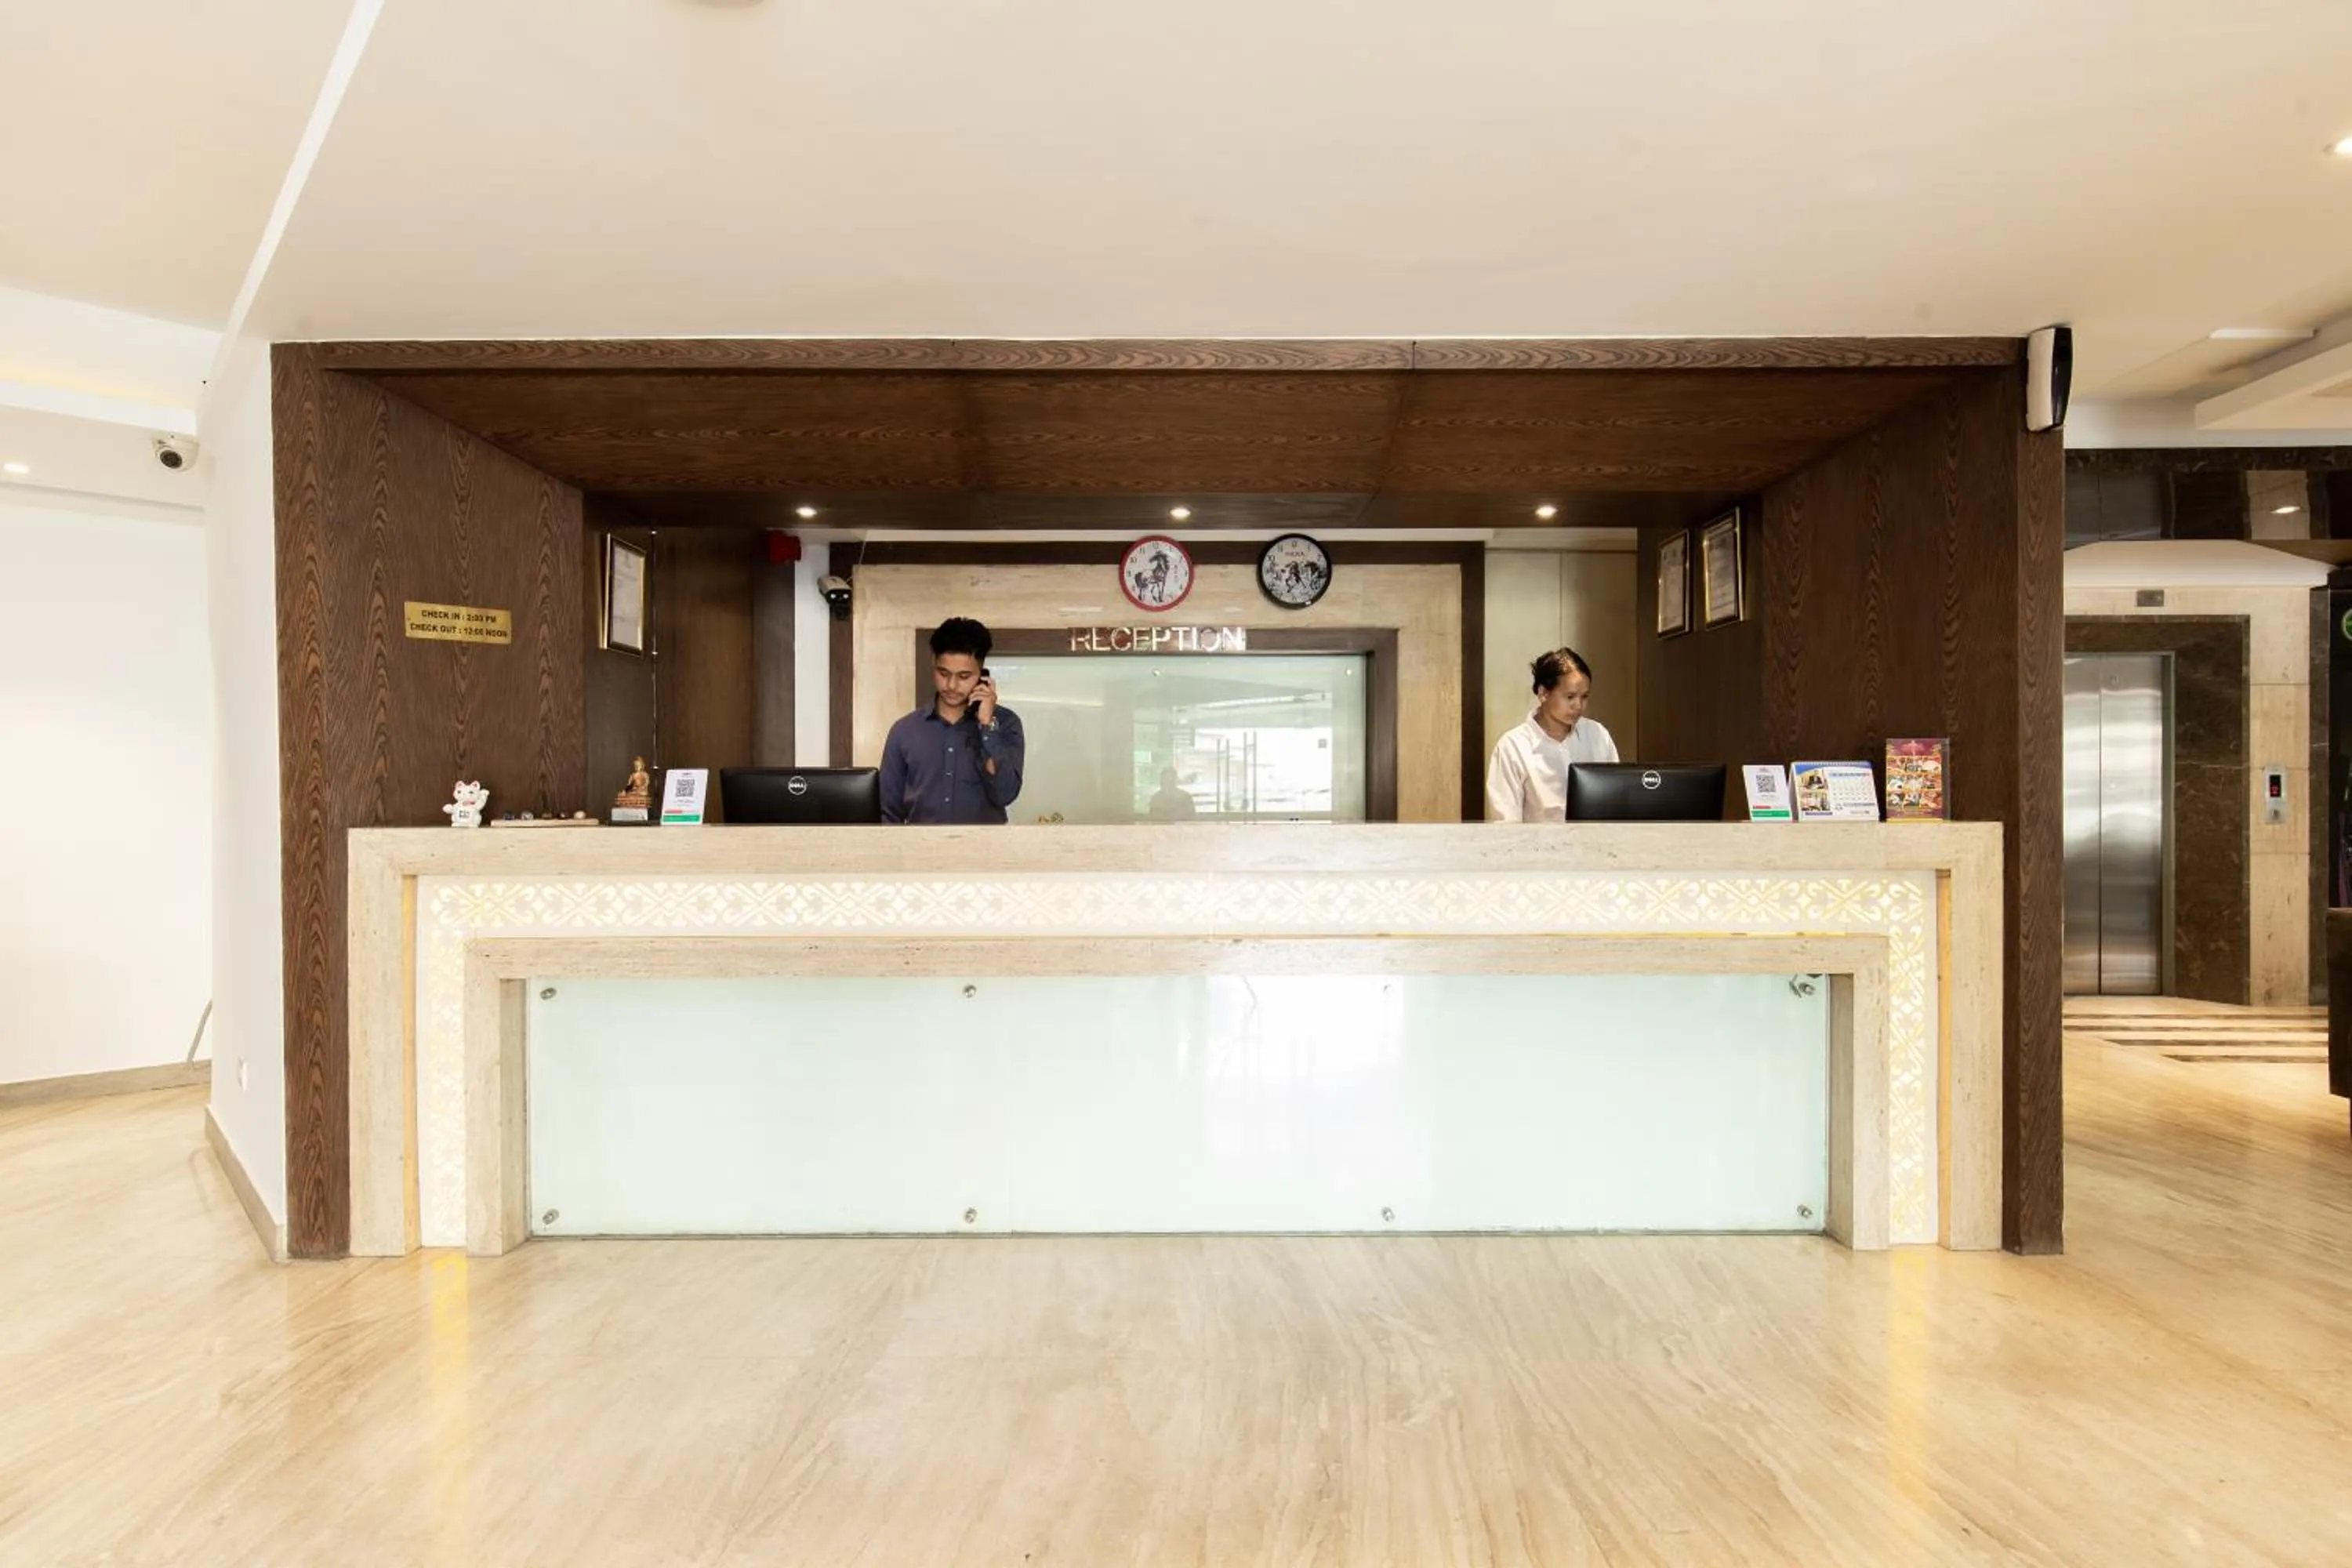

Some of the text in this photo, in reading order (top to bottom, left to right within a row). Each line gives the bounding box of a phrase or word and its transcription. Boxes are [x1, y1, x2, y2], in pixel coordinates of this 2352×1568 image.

[421, 609, 449, 619] CHECK
[410, 622, 438, 633] CHECK
[440, 625, 456, 634] OUT
[485, 628, 507, 637] NOON
[1068, 626, 1247, 652] RECEPTION
